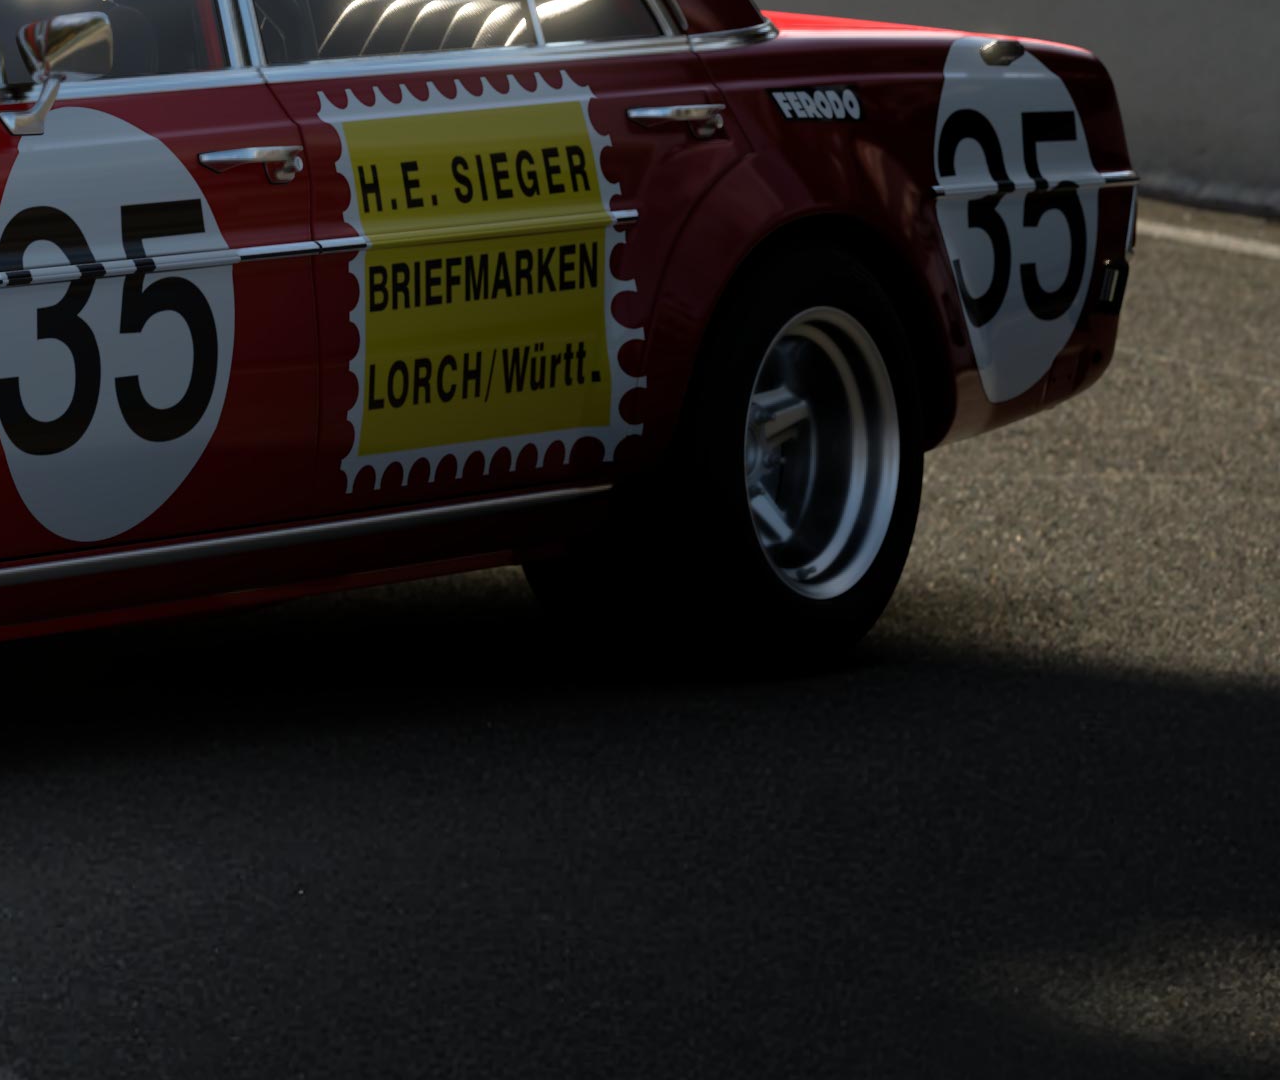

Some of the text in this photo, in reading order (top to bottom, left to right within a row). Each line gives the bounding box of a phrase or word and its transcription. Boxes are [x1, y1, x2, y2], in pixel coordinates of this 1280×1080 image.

[771, 87, 862, 121] FERODO
[357, 144, 592, 214] H.E. SIEGER
[938, 108, 1087, 326] 35
[368, 242, 599, 312] BRIEFMARKEN
[367, 341, 602, 411] LORCH/Württ.
